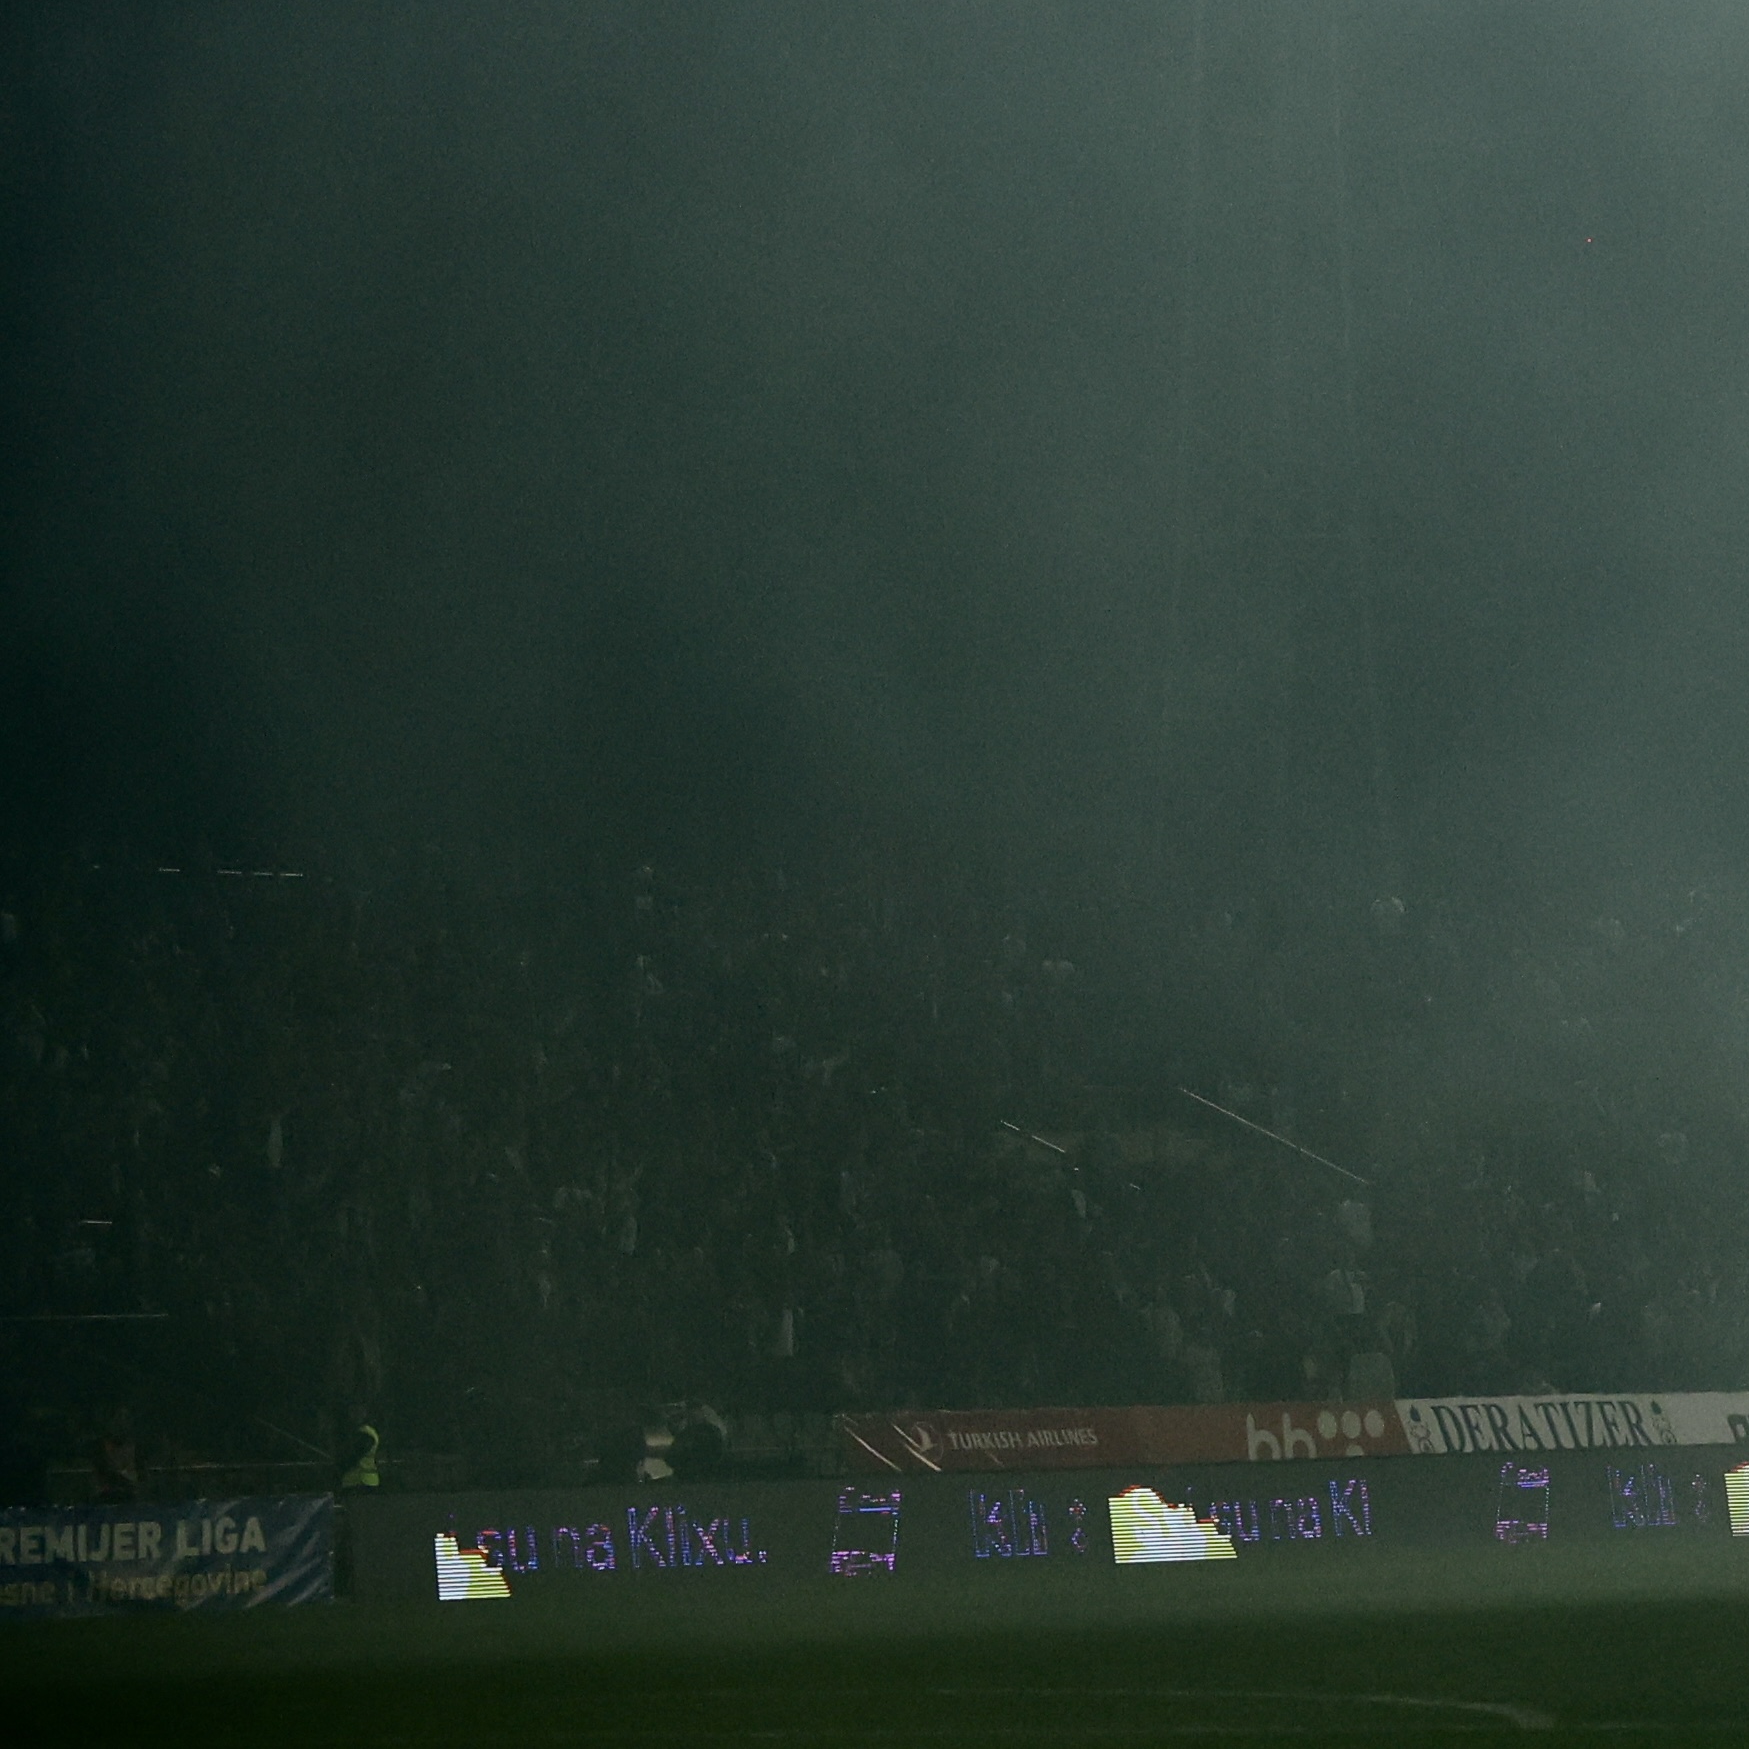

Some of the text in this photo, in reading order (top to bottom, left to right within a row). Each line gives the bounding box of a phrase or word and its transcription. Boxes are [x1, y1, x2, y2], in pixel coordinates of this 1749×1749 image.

[949, 1427, 1099, 1450] TURKISH AIRLINES
[1431, 1401, 1651, 1451] DERATIZER
[175, 1515, 268, 1557] LIGA
